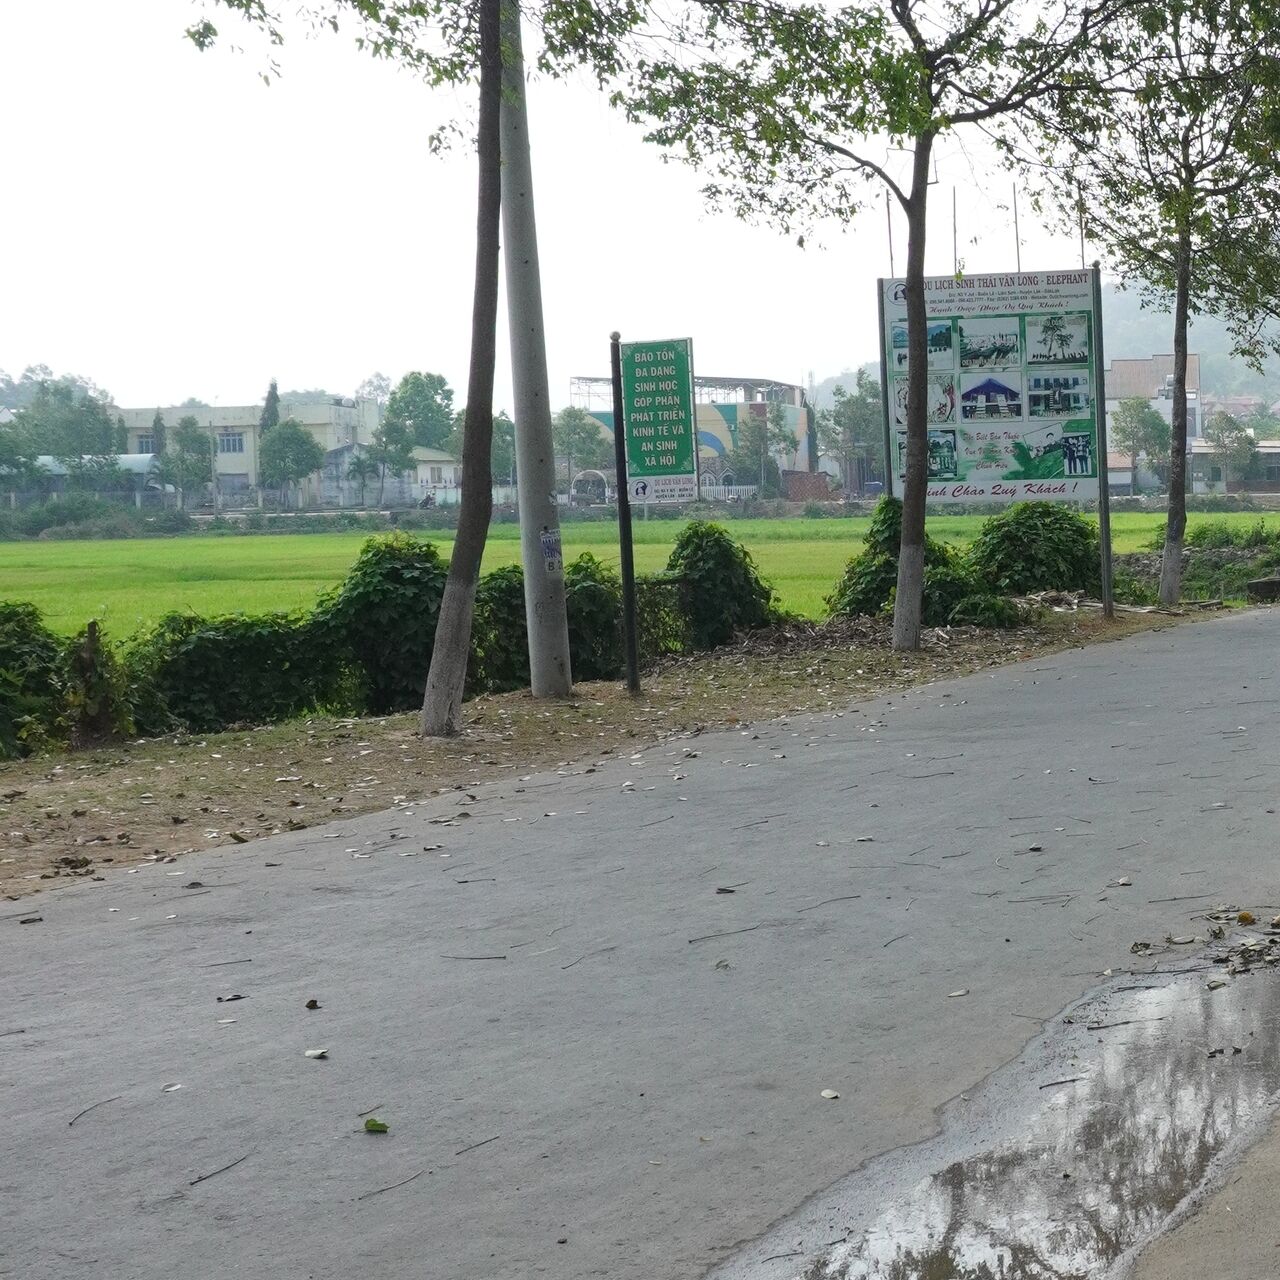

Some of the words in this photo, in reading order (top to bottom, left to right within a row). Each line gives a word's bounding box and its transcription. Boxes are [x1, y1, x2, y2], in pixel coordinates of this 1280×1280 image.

[935, 279, 954, 292] LỊCH
[955, 278, 975, 289] SINH
[1018, 275, 1039, 287] LONG
[1046, 272, 1088, 286] ELEPHANT
[634, 349, 654, 363] BẢO
[656, 346, 675, 361] TỒN
[635, 368, 648, 377] ĐA
[650, 365, 676, 378] DẠNG
[634, 381, 656, 393] SINH
[659, 380, 678, 393] HỌC
[634, 394, 652, 408] GÓP
[655, 392, 680, 406] PHẦN
[630, 408, 655, 423] PHÁT
[657, 404, 686, 421] TRIỂN
[632, 426, 655, 437] KINH
[657, 422, 670, 436] TẾ
[672, 422, 685, 435] VÀ
[641, 442, 654, 452] AN
[656, 440, 677, 451] SINH
[645, 454, 657, 466] XÃ
[660, 453, 676, 466] HỘI
[951, 484, 985, 498] Chào
[991, 484, 1017, 498] Quý
[1024, 482, 1066, 495] Khách
[1072, 482, 1078, 492] !
